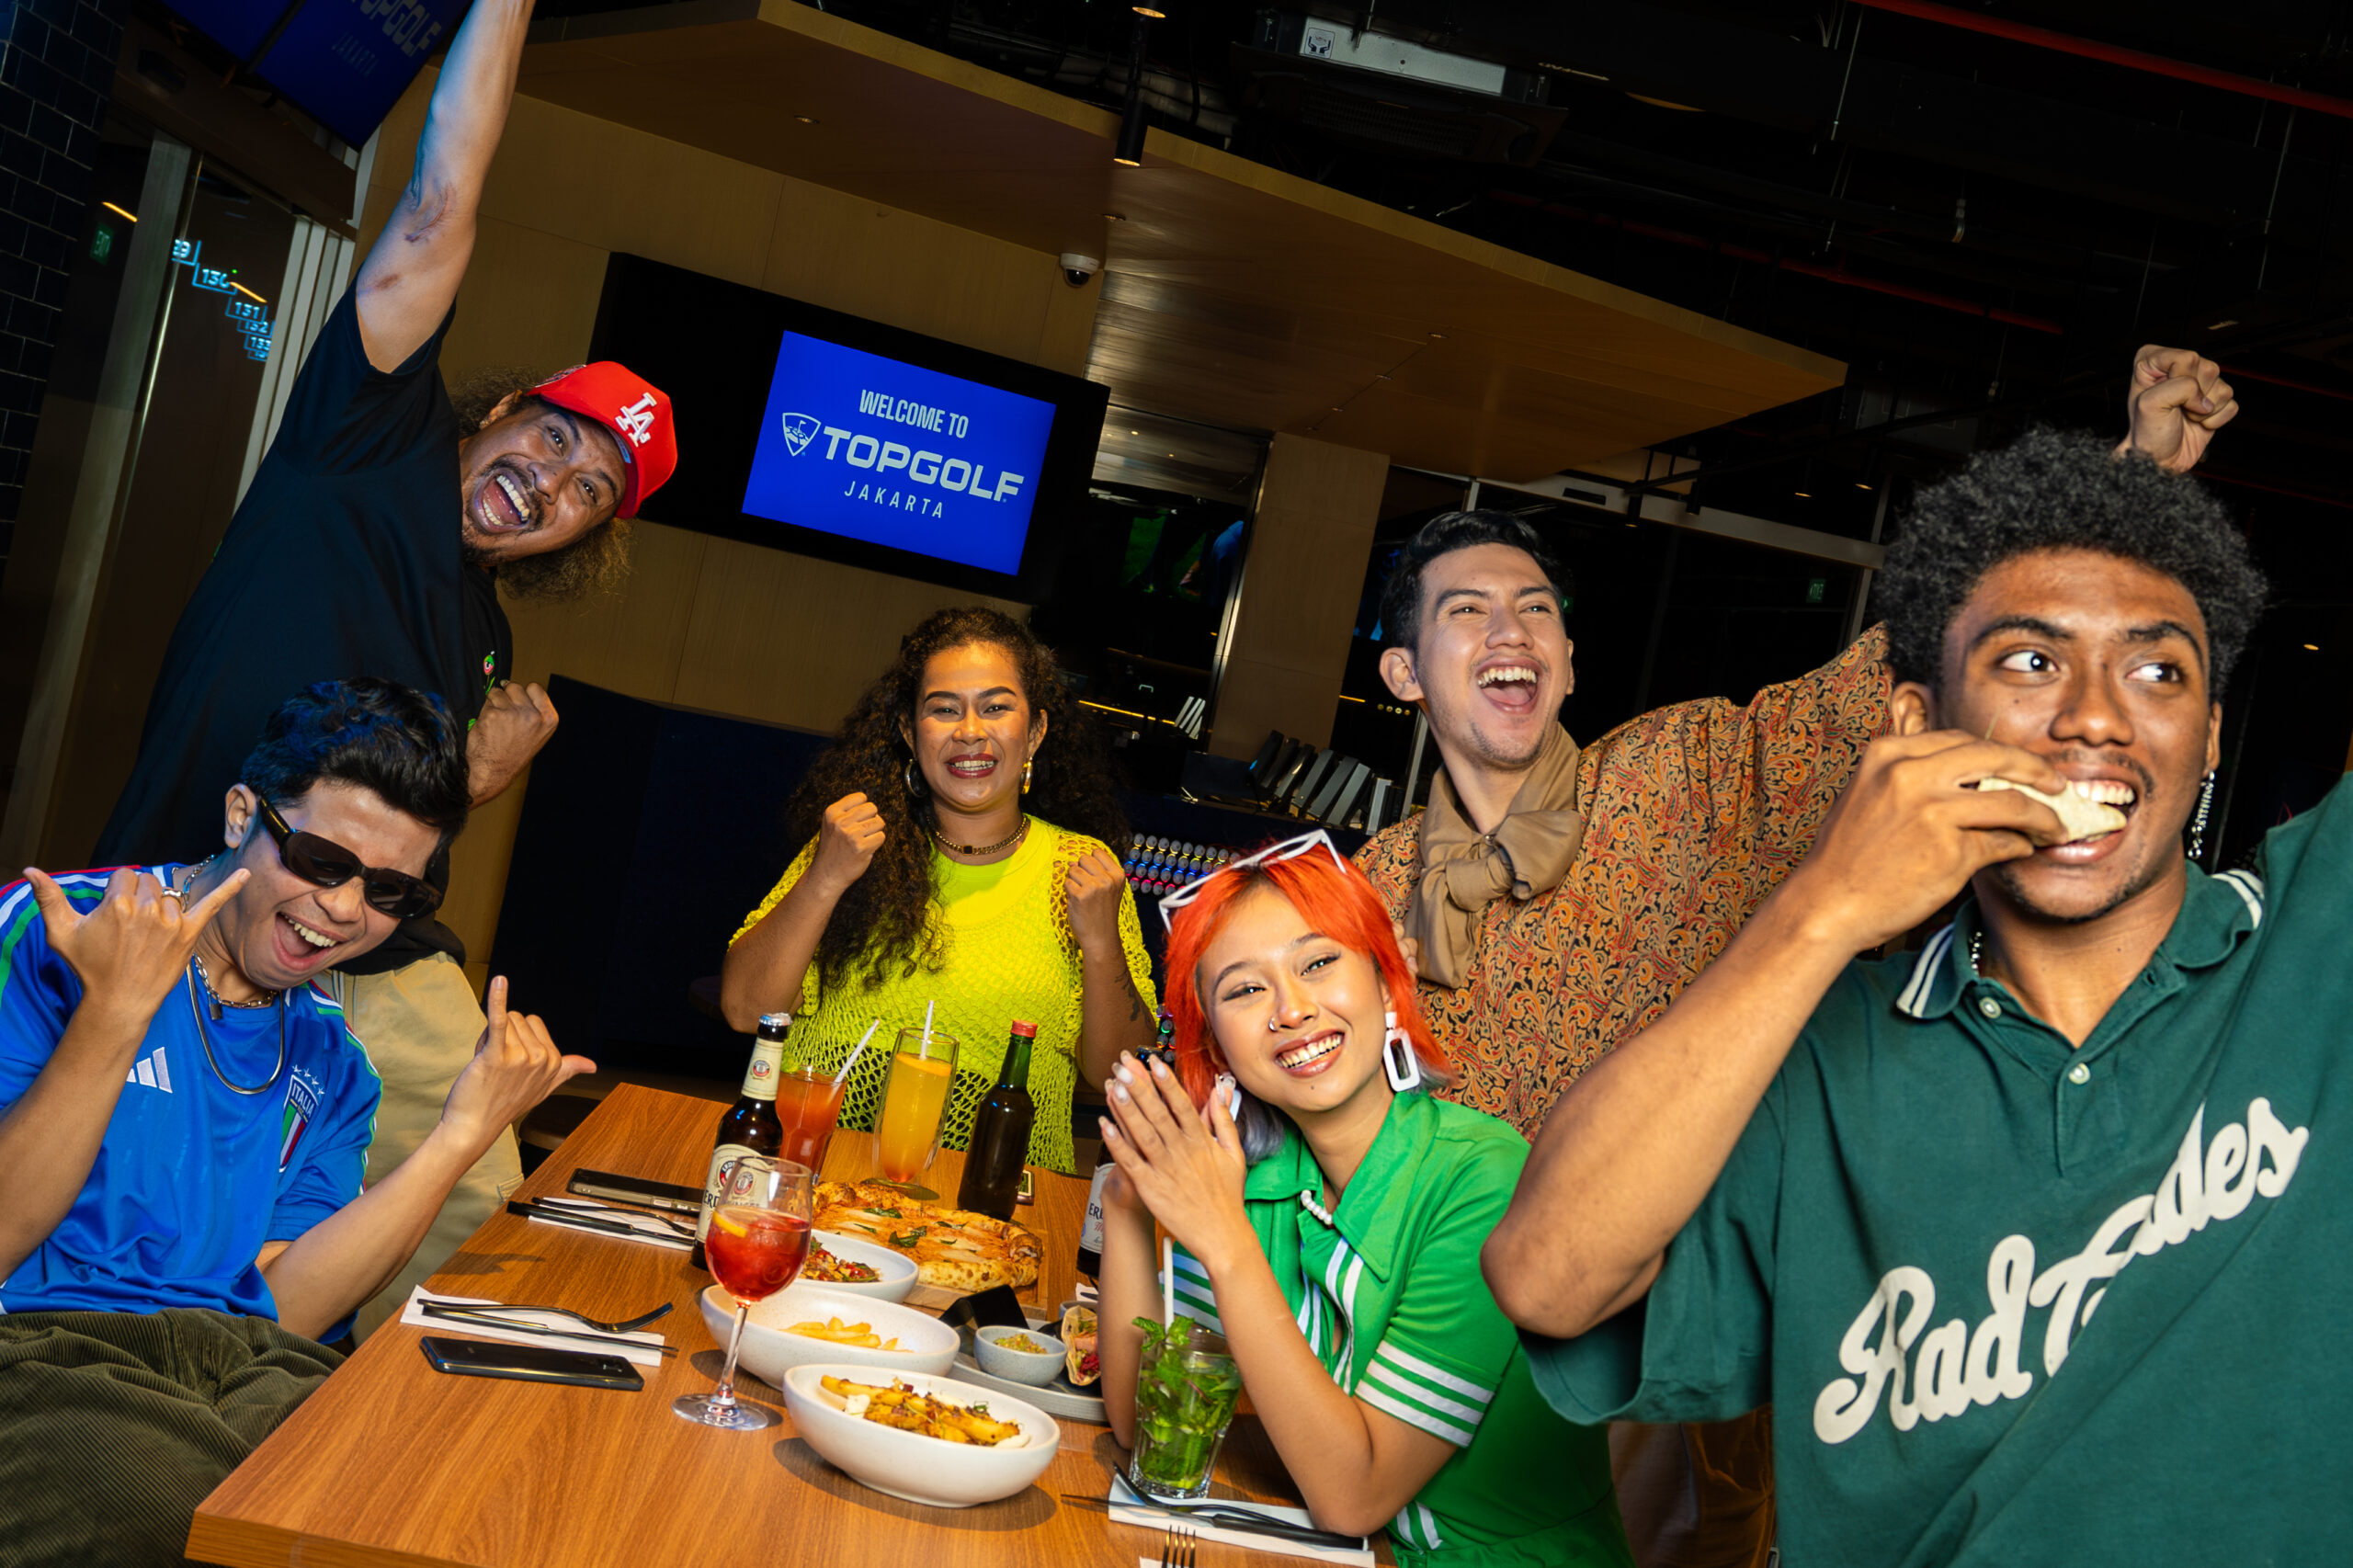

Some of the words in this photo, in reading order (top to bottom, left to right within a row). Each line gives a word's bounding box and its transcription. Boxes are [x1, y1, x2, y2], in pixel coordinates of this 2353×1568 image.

[234, 301, 260, 320] 131
[615, 392, 658, 448] LA
[858, 389, 946, 433] WELCOME
[948, 412, 969, 438] TO
[823, 426, 1025, 502] TOPGOLF
[844, 481, 943, 518] JAKARTA
[291, 1082, 315, 1119] ITALIA
[1813, 1233, 2036, 1445] Rad
